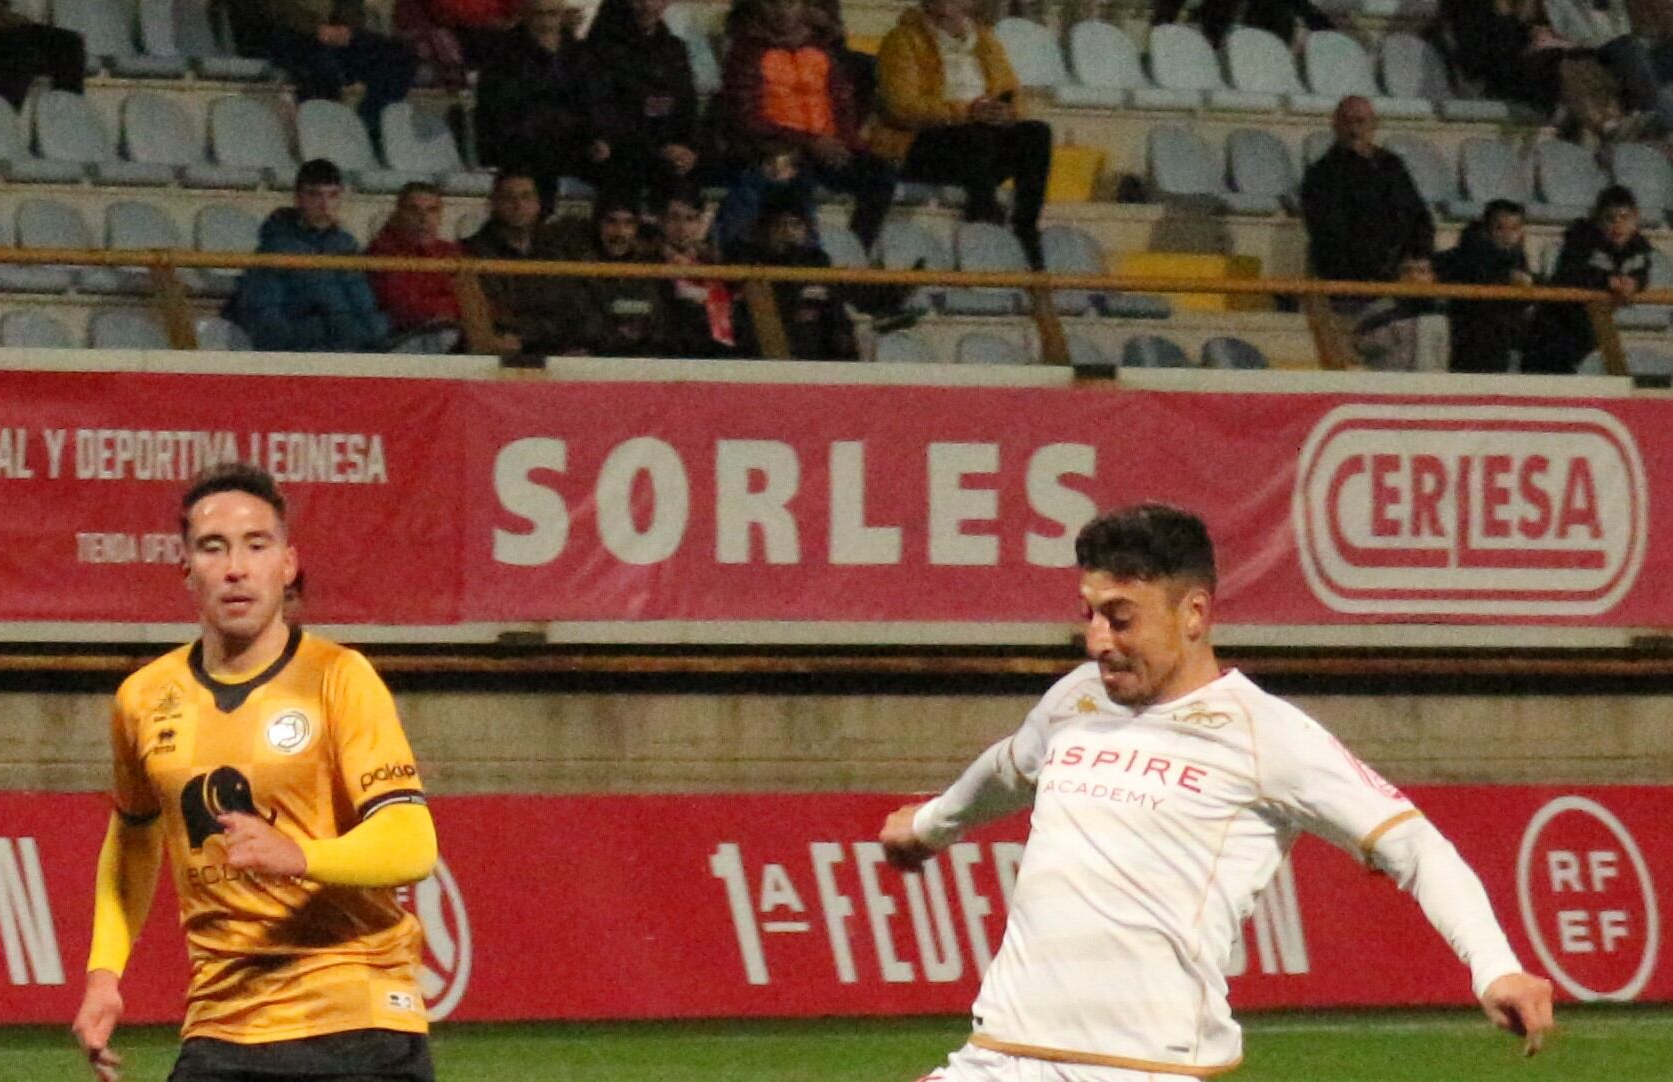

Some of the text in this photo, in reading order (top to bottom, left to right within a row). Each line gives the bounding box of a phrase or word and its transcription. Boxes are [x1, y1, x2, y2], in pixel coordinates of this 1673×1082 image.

[43, 428, 67, 480] Y
[493, 436, 1097, 566] SORLES
[1043, 780, 1165, 811] ACADEMY
[1546, 850, 1619, 893] RF
[1557, 910, 1630, 953] EF
